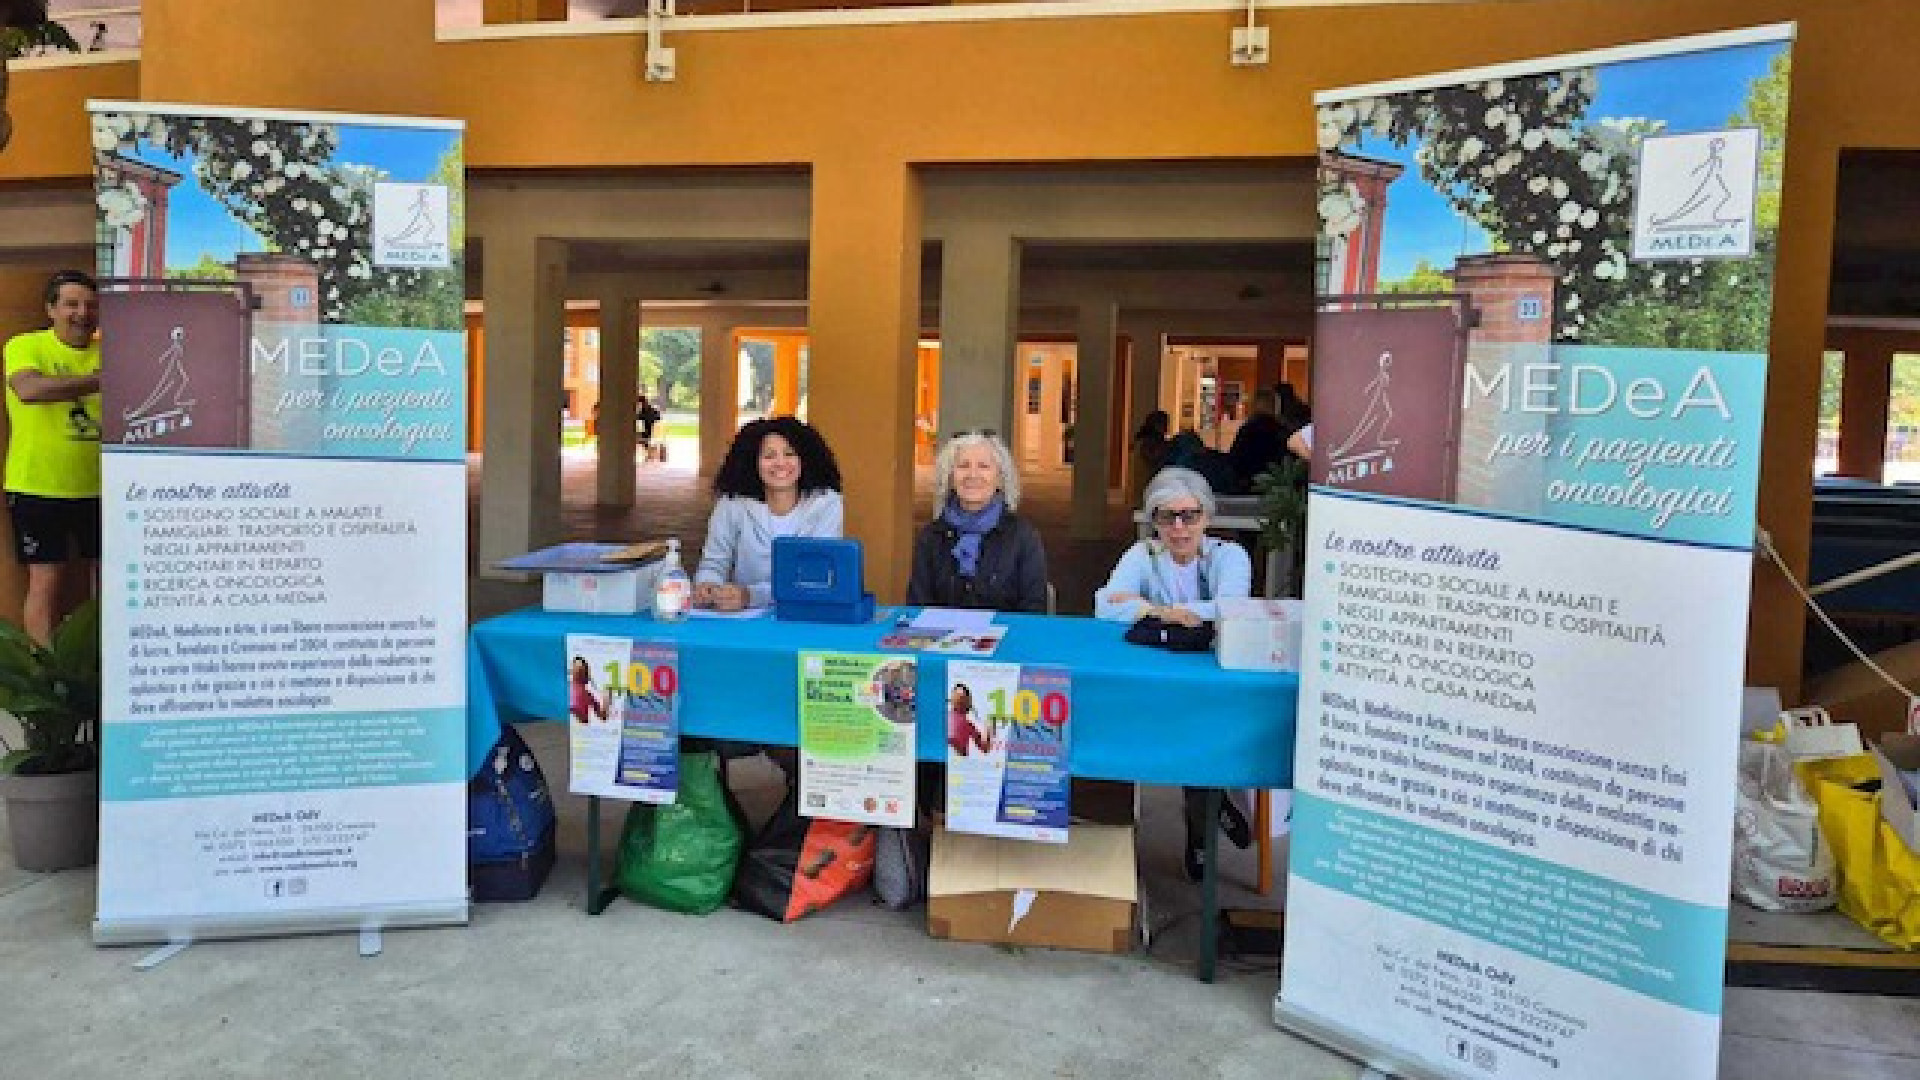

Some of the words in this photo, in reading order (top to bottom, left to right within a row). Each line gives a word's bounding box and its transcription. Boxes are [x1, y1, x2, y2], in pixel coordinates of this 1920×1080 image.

[250, 337, 446, 376] MEDeA
[277, 388, 325, 412] per
[332, 387, 341, 407] i
[344, 387, 452, 430] pazienti
[1461, 359, 1734, 422] MEDeA
[323, 420, 453, 454] oncologici
[1491, 430, 1550, 466] per
[1560, 427, 1573, 457] i
[1579, 434, 1736, 479] pazienti
[126, 483, 146, 500] Le
[152, 482, 216, 500] nostre
[221, 481, 291, 499] attività
[1547, 474, 1733, 530] oncologici
[144, 507, 234, 521] SOSTEGNO
[237, 506, 299, 519] SOCIALE
[305, 506, 315, 518] A
[320, 505, 372, 518] MALATI
[374, 505, 382, 517] E
[144, 542, 189, 555] NEGLI
[195, 540, 305, 554] APPARTAMENTI
[144, 560, 233, 573] VOLONTARI
[238, 559, 254, 571] IN
[259, 558, 322, 571] REPARTO
[1324, 530, 1344, 552] Le
[1350, 533, 1413, 560] nostre
[1421, 541, 1500, 570] attività
[144, 576, 208, 590] RICERCA
[215, 574, 324, 588] ONCOLOGICA
[1340, 561, 1432, 589] SOSTEGNO
[1438, 575, 1510, 600] SOCIALE
[1516, 586, 1530, 603] A
[1535, 588, 1601, 612] MALATI
[1608, 598, 1618, 615] E
[1338, 601, 1382, 623] NEGLI
[1390, 609, 1512, 643] APPARTAMENTI
[1436, 596, 1538, 626] TRASPORTO
[1544, 612, 1554, 628] E
[1560, 610, 1665, 645] OSPITALITÀ
[1337, 639, 1400, 666] RICERCA
[1406, 652, 1534, 690] ONCOLOGICA
[1339, 619, 1427, 650] VOLONTARI
[1434, 636, 1451, 654] IN
[1457, 640, 1533, 669] REPARTO
[604, 659, 677, 698] 100
[1335, 656, 1398, 686] ATTIVITÀ
[1404, 672, 1416, 690] A
[1422, 676, 1467, 700] CASA
[1472, 686, 1536, 713] MEDeA
[987, 687, 1070, 727] 100
